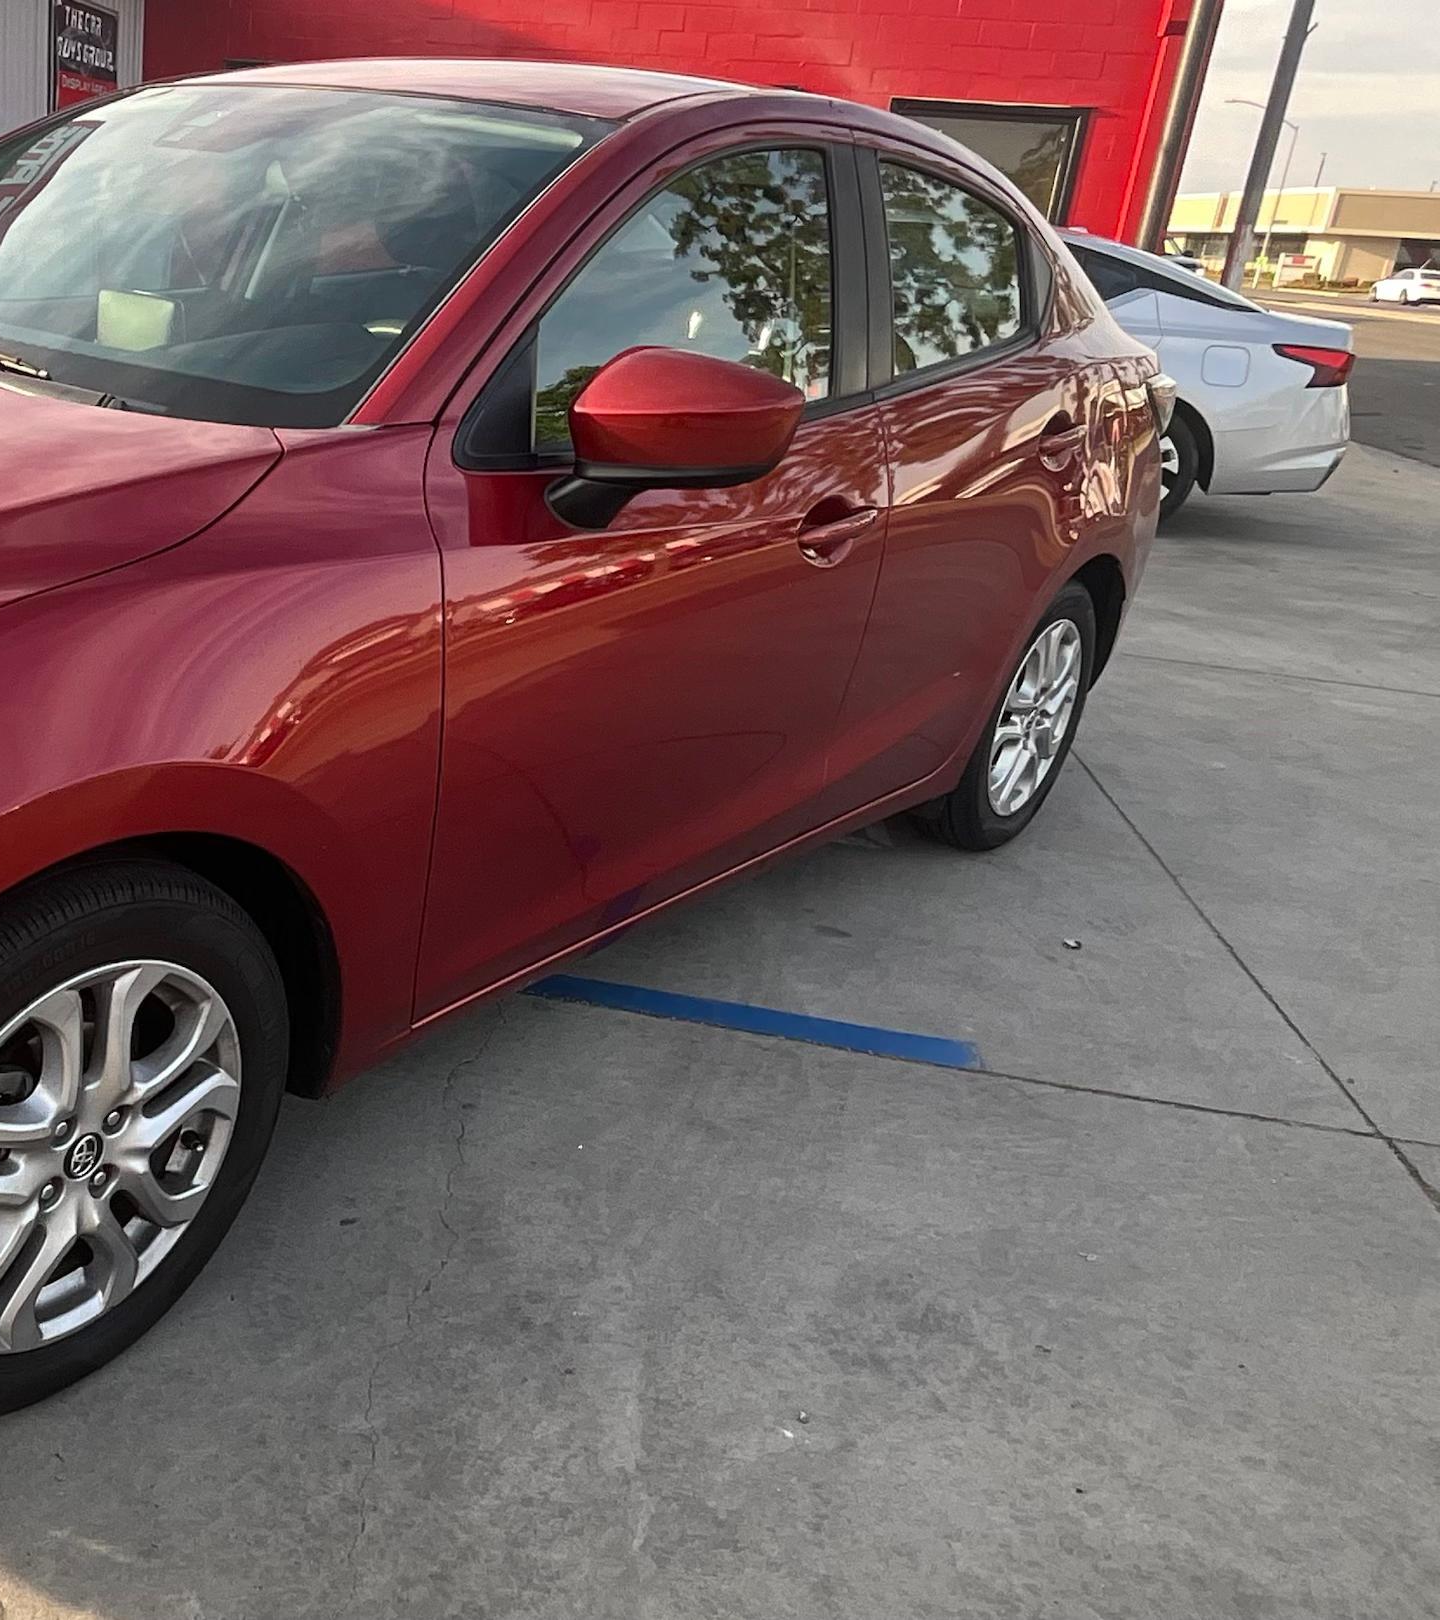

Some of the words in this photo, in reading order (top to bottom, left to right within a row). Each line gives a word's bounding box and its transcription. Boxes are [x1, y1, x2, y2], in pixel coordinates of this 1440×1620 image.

[65, 5, 84, 30] THE
[84, 12, 102, 37] CAR
[57, 36, 82, 61] GUYS
